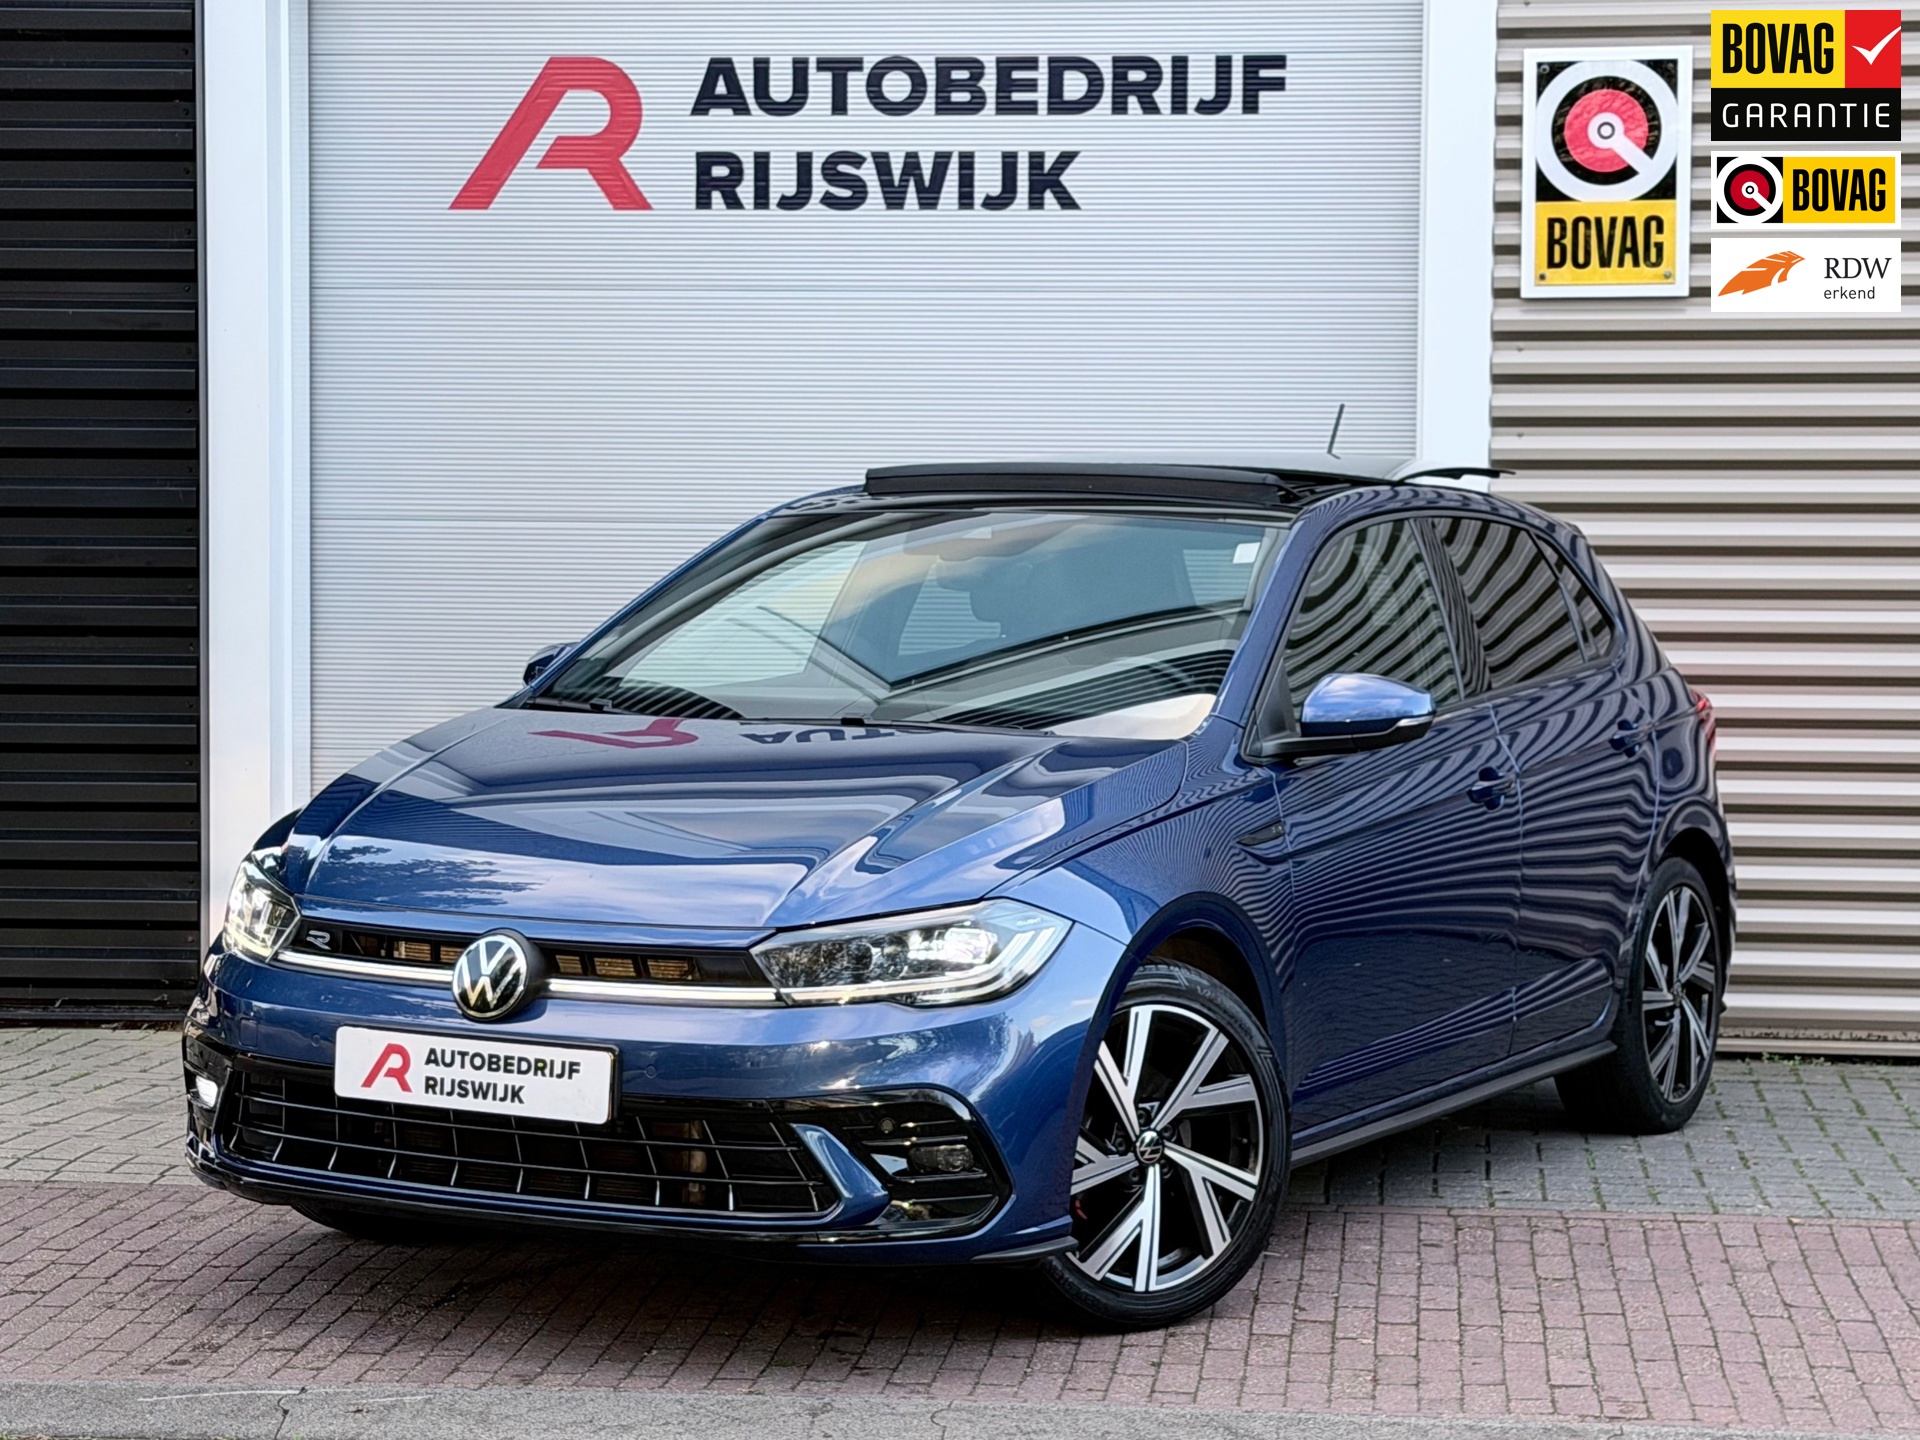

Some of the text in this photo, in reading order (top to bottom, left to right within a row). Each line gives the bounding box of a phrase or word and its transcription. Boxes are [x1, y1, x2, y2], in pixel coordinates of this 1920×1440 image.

[690, 54, 1287, 117] AUTOBEDRIJF
[695, 150, 1081, 211] RIJSWIJK
[1546, 214, 1664, 270] BOVAG
[424, 1047, 581, 1081] AUTOBEDRIJF
[424, 1075, 525, 1105] RIJSWIJK
